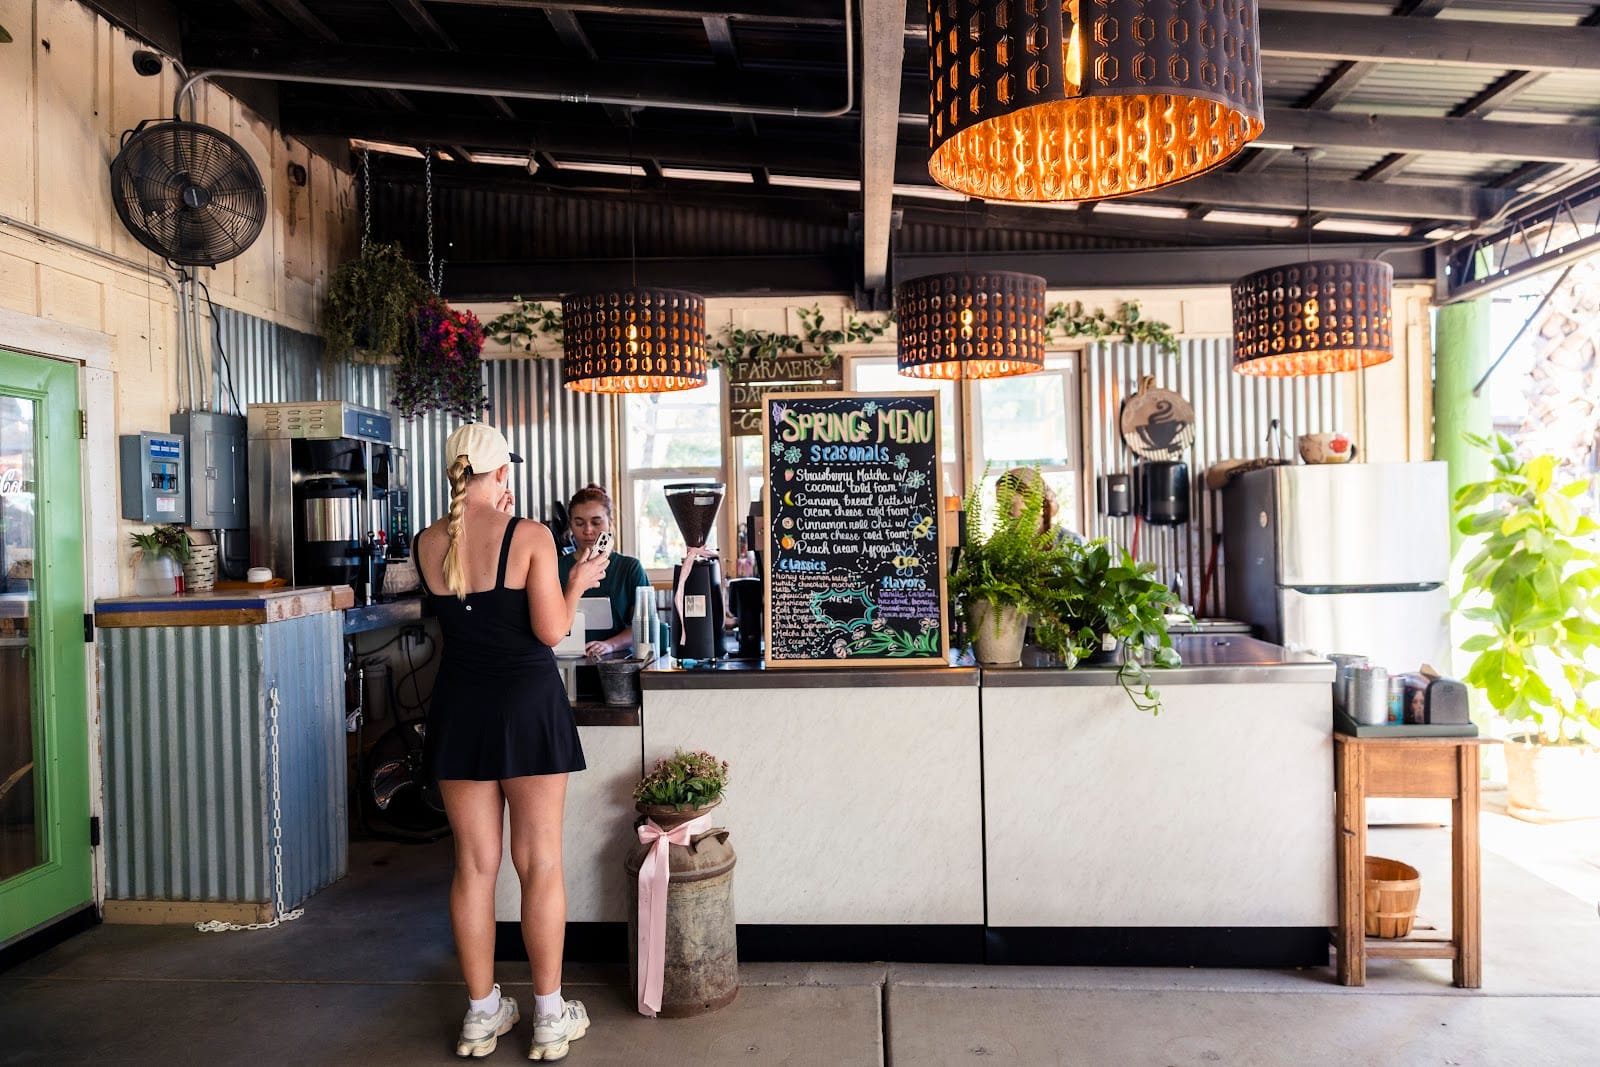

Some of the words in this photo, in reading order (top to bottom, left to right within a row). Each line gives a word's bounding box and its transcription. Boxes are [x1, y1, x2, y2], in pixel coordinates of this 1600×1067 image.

[737, 358, 831, 380] FARMER'S
[782, 408, 869, 443] SPRING
[876, 408, 933, 444] MENU
[796, 467, 853, 486] Strawberry
[857, 468, 890, 481] Matcha
[873, 483, 897, 493] foam
[795, 493, 840, 506] Banana
[844, 494, 873, 506] bread
[878, 494, 903, 506] latte
[834, 506, 863, 517] cheese
[796, 518, 849, 530] Cinnamon
[849, 519, 869, 529] roll
[830, 530, 860, 541] cheese
[794, 540, 830, 554] Peach
[829, 595, 852, 604] NEW!
